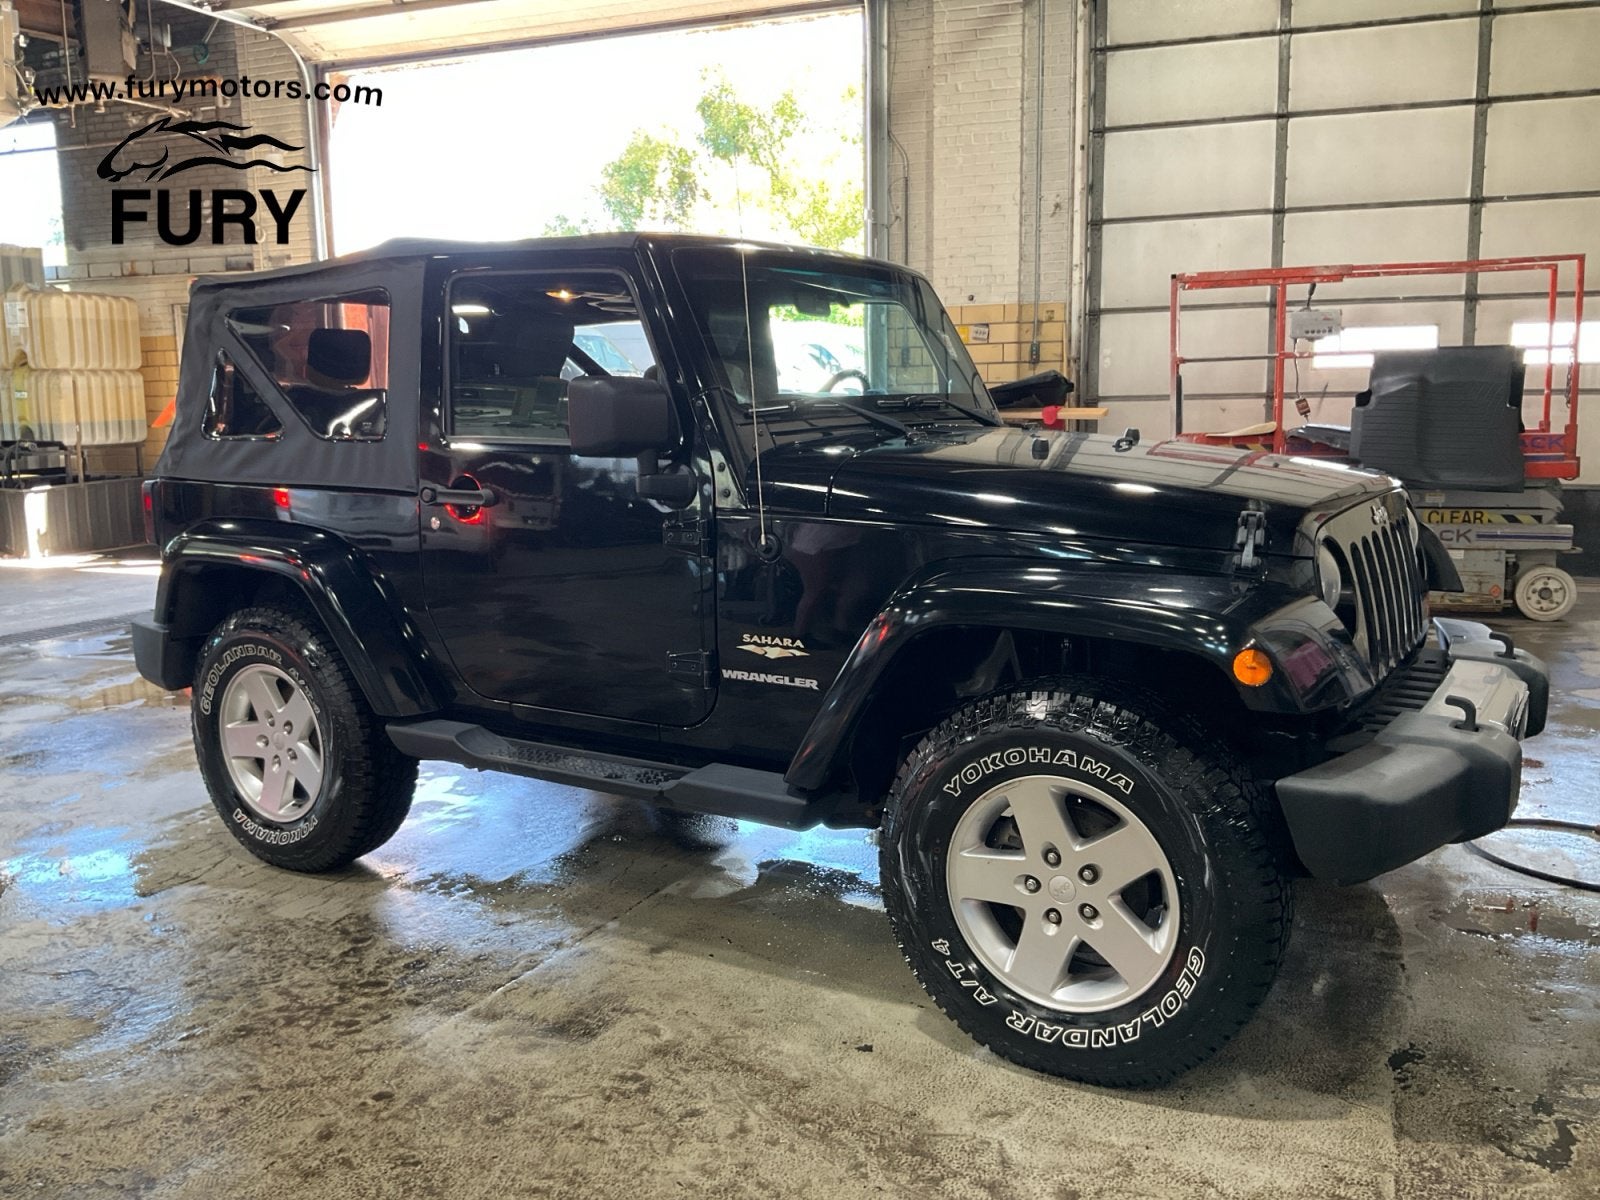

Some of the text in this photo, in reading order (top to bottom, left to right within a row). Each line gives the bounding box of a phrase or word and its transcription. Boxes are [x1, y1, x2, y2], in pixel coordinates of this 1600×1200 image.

[1427, 510, 1485, 524] CLEAR
[742, 633, 804, 648] SAHARA
[199, 643, 283, 716] GEOLANDAR
[721, 668, 819, 690] WRANGLER
[942, 747, 1135, 798] YOKOHAMA
[233, 807, 319, 846] YOKOHAMA
[1005, 945, 1206, 1049] GEOLANDAR
